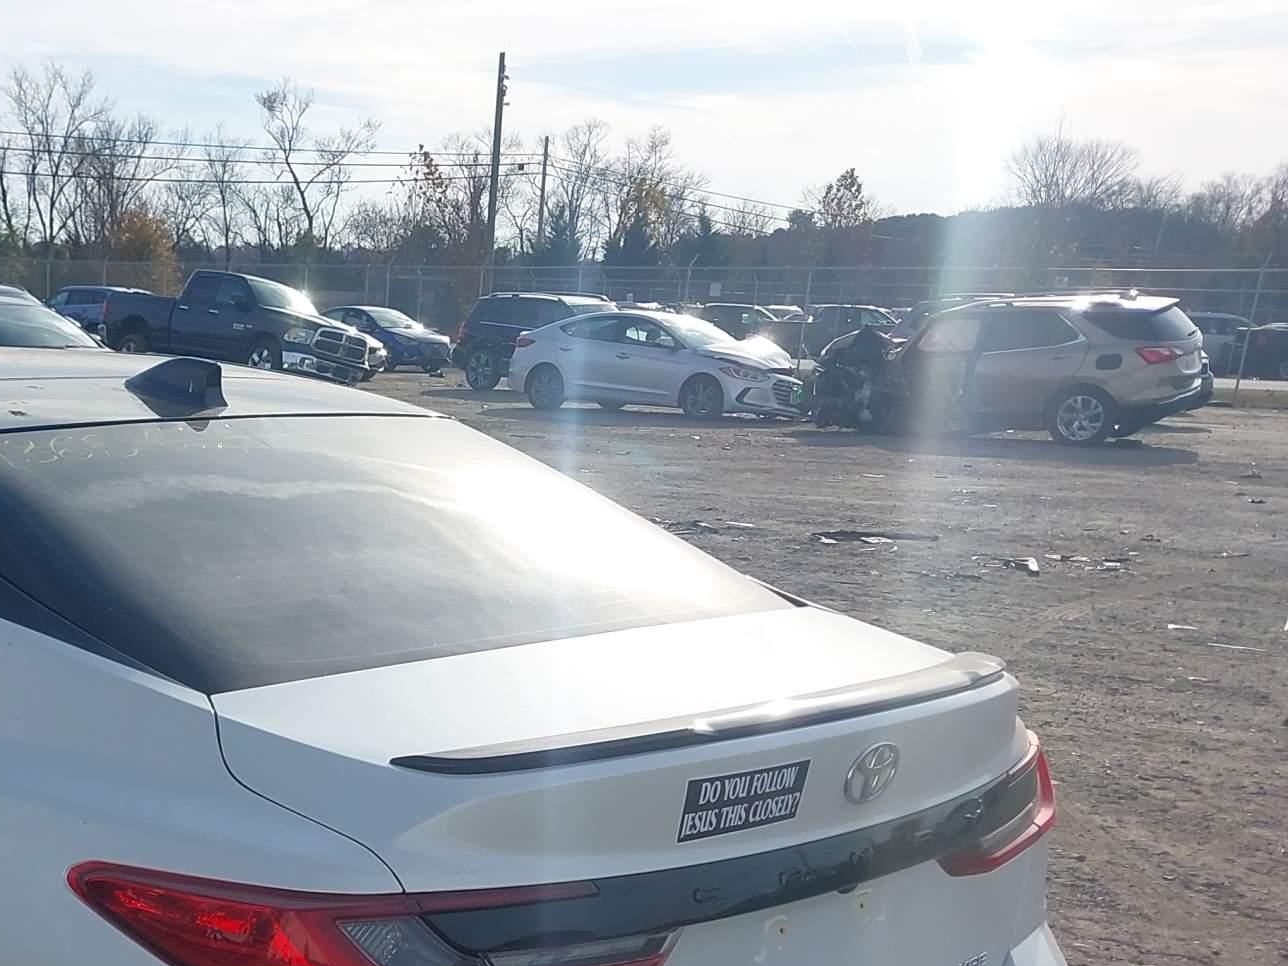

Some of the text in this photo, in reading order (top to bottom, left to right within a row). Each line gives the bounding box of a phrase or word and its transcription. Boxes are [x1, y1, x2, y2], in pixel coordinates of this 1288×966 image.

[698, 766, 800, 805] DO YOU FOLLOW
[679, 791, 801, 839] JESUS THIS CLOSELY?
